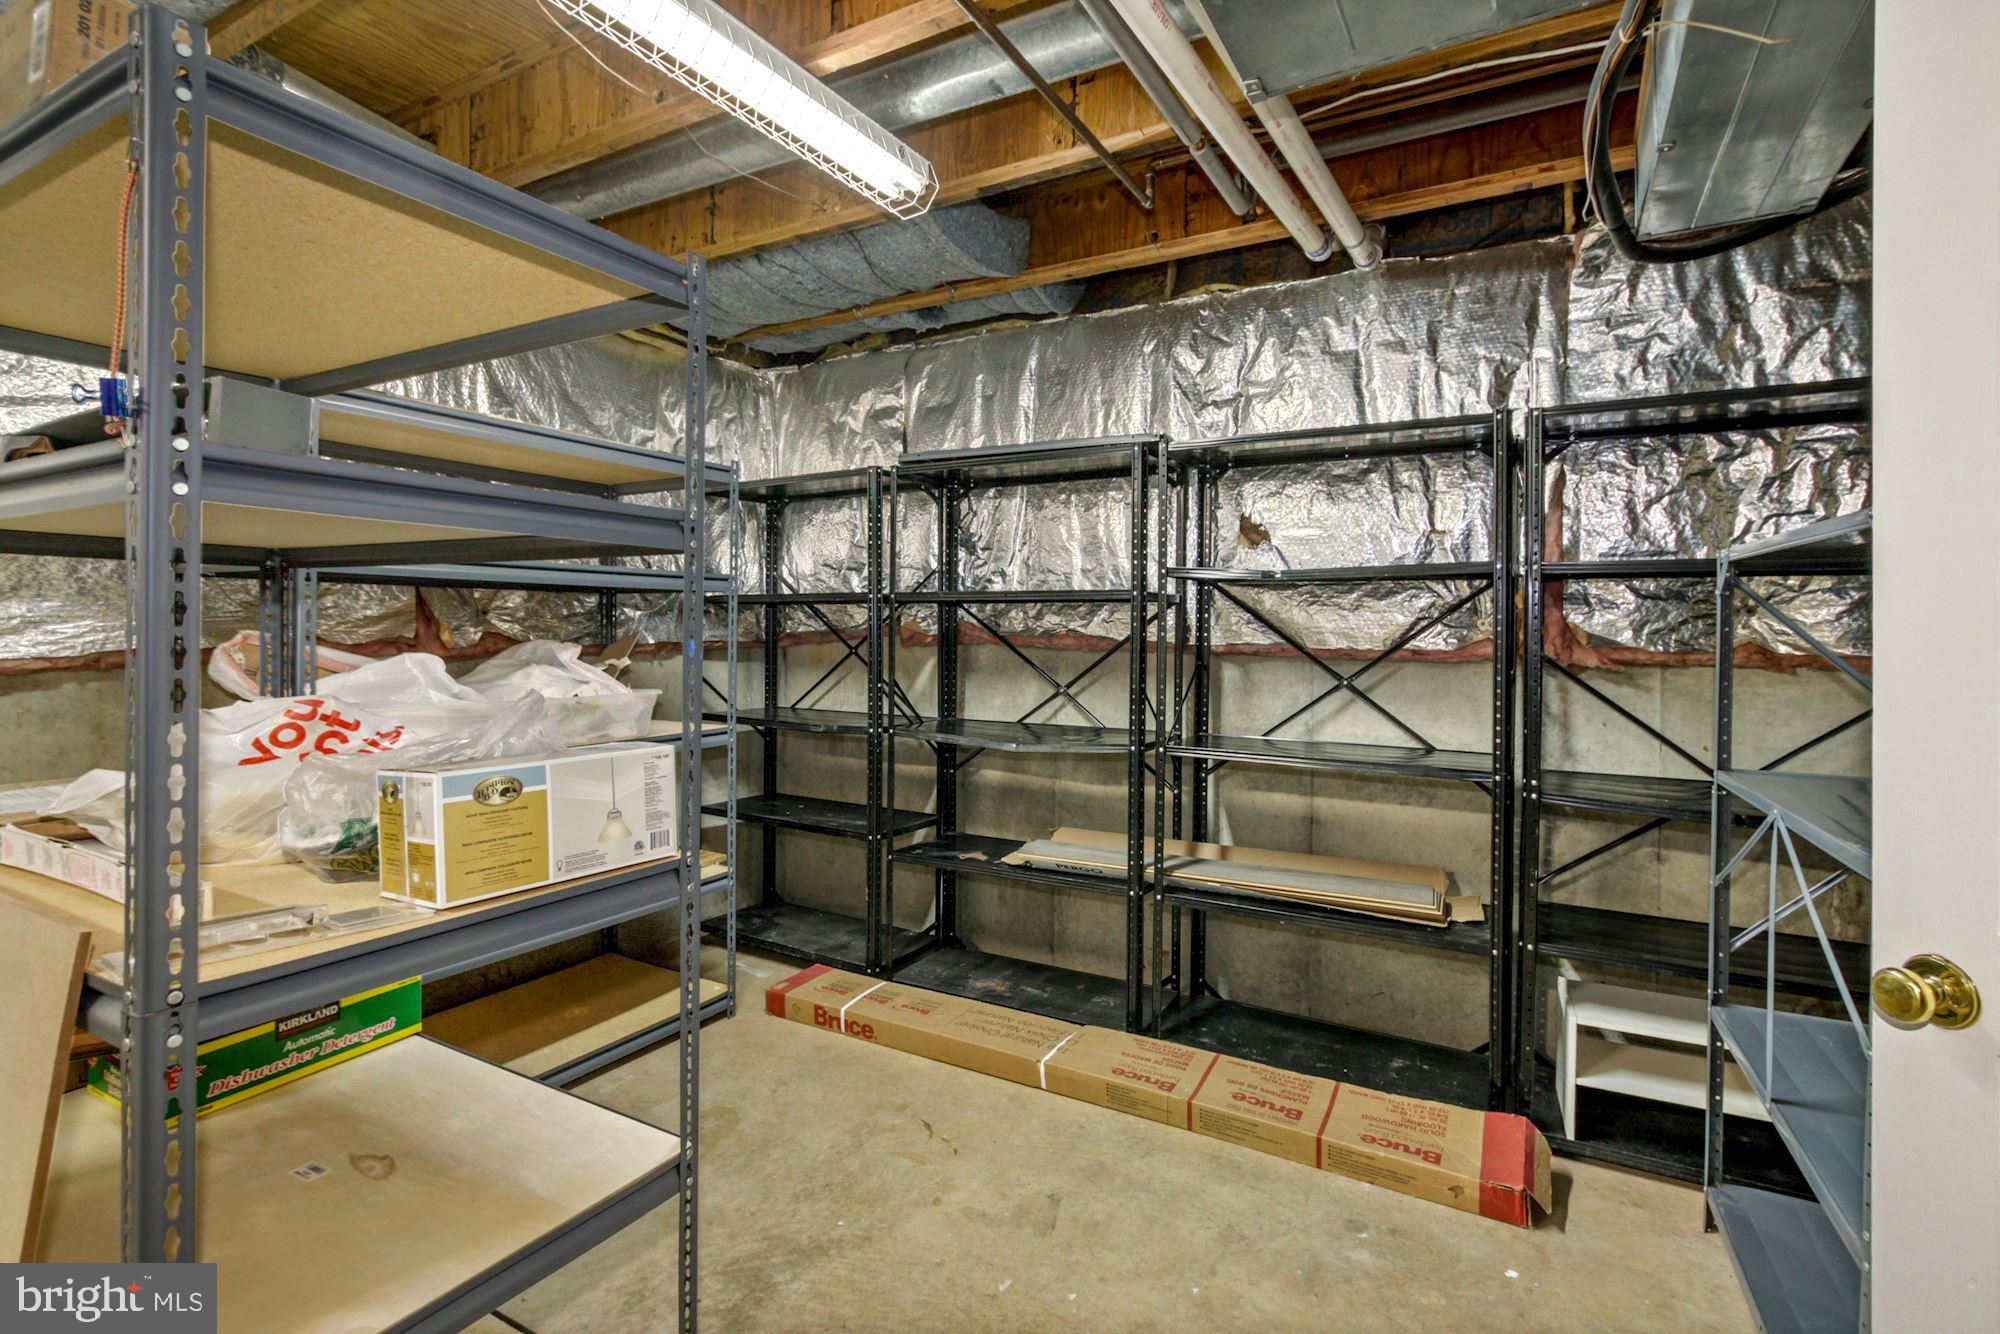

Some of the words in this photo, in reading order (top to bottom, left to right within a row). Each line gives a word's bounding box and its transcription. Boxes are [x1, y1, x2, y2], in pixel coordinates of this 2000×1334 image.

[76, 15, 91, 39] 201
[1055, 863, 1103, 874] PERGO
[278, 1005, 339, 1033] KIRKLAND
[282, 1026, 336, 1053] Automatic
[206, 1048, 320, 1099] Dishwasher
[320, 1016, 396, 1056] Detergent
[1112, 1067, 1176, 1093] Bruce
[1232, 1092, 1303, 1121] Bruce
[1361, 1114, 1416, 1131] HARDWOOD
[1419, 1126, 1447, 1137] SOLID
[1360, 1135, 1441, 1166] Bruce
